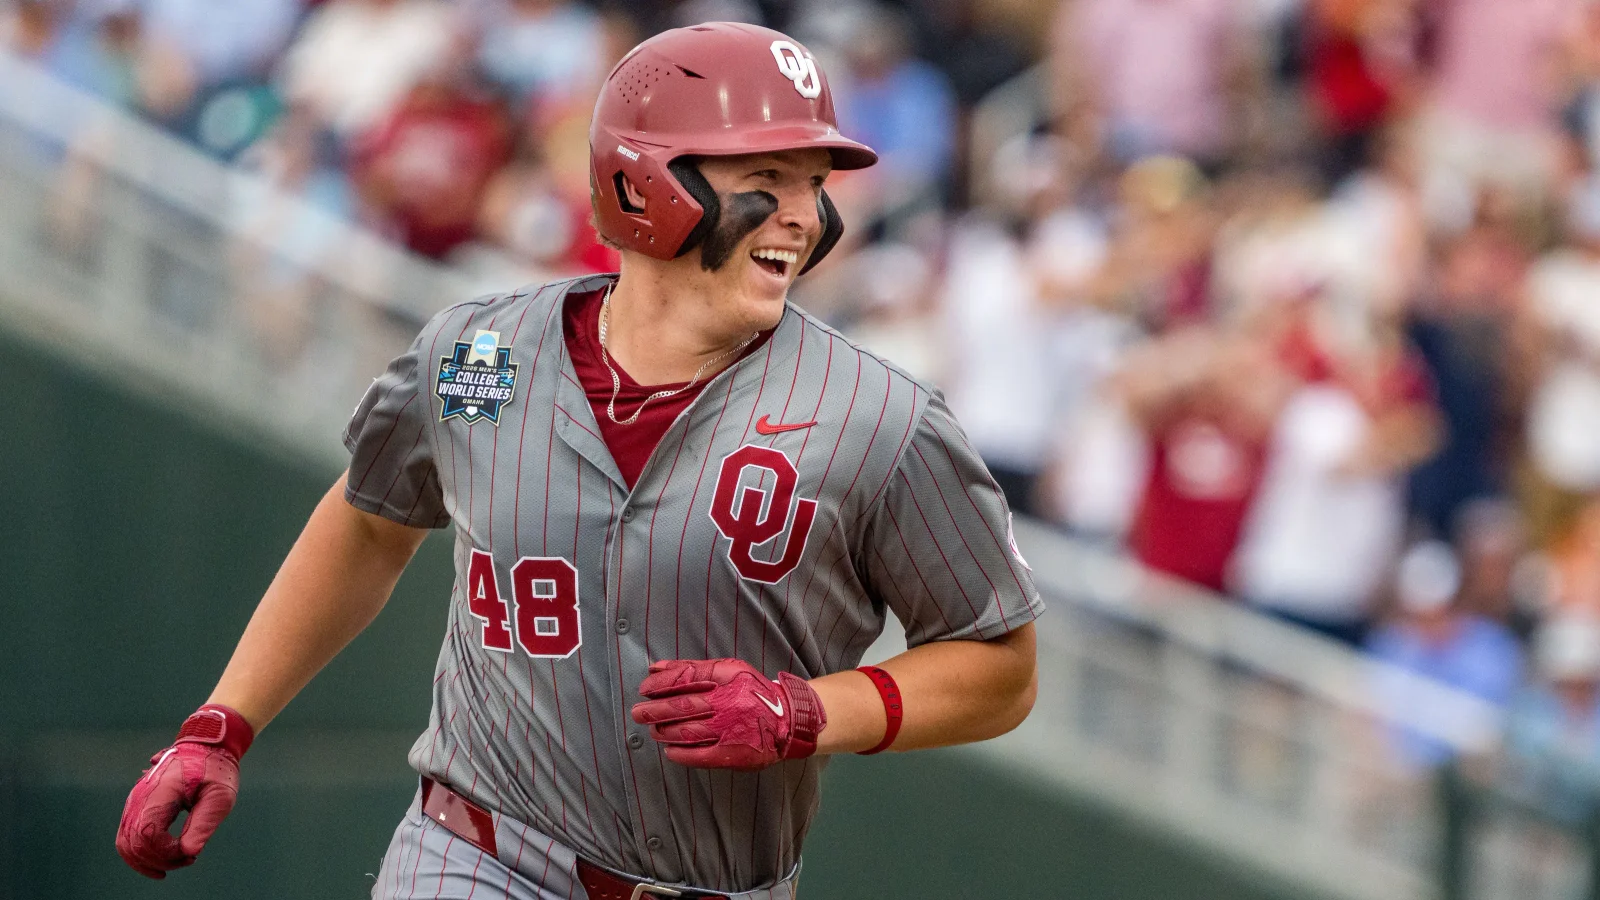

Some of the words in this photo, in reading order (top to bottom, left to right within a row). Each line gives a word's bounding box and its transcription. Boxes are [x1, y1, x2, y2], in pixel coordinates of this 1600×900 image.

[770, 40, 821, 99] OU
[476, 343, 494, 351] NCAA
[438, 382, 475, 397] WORLD
[475, 385, 511, 400] SERIES
[455, 371, 501, 386] COLLEGE
[709, 444, 819, 585] OU
[468, 548, 582, 658] 48
